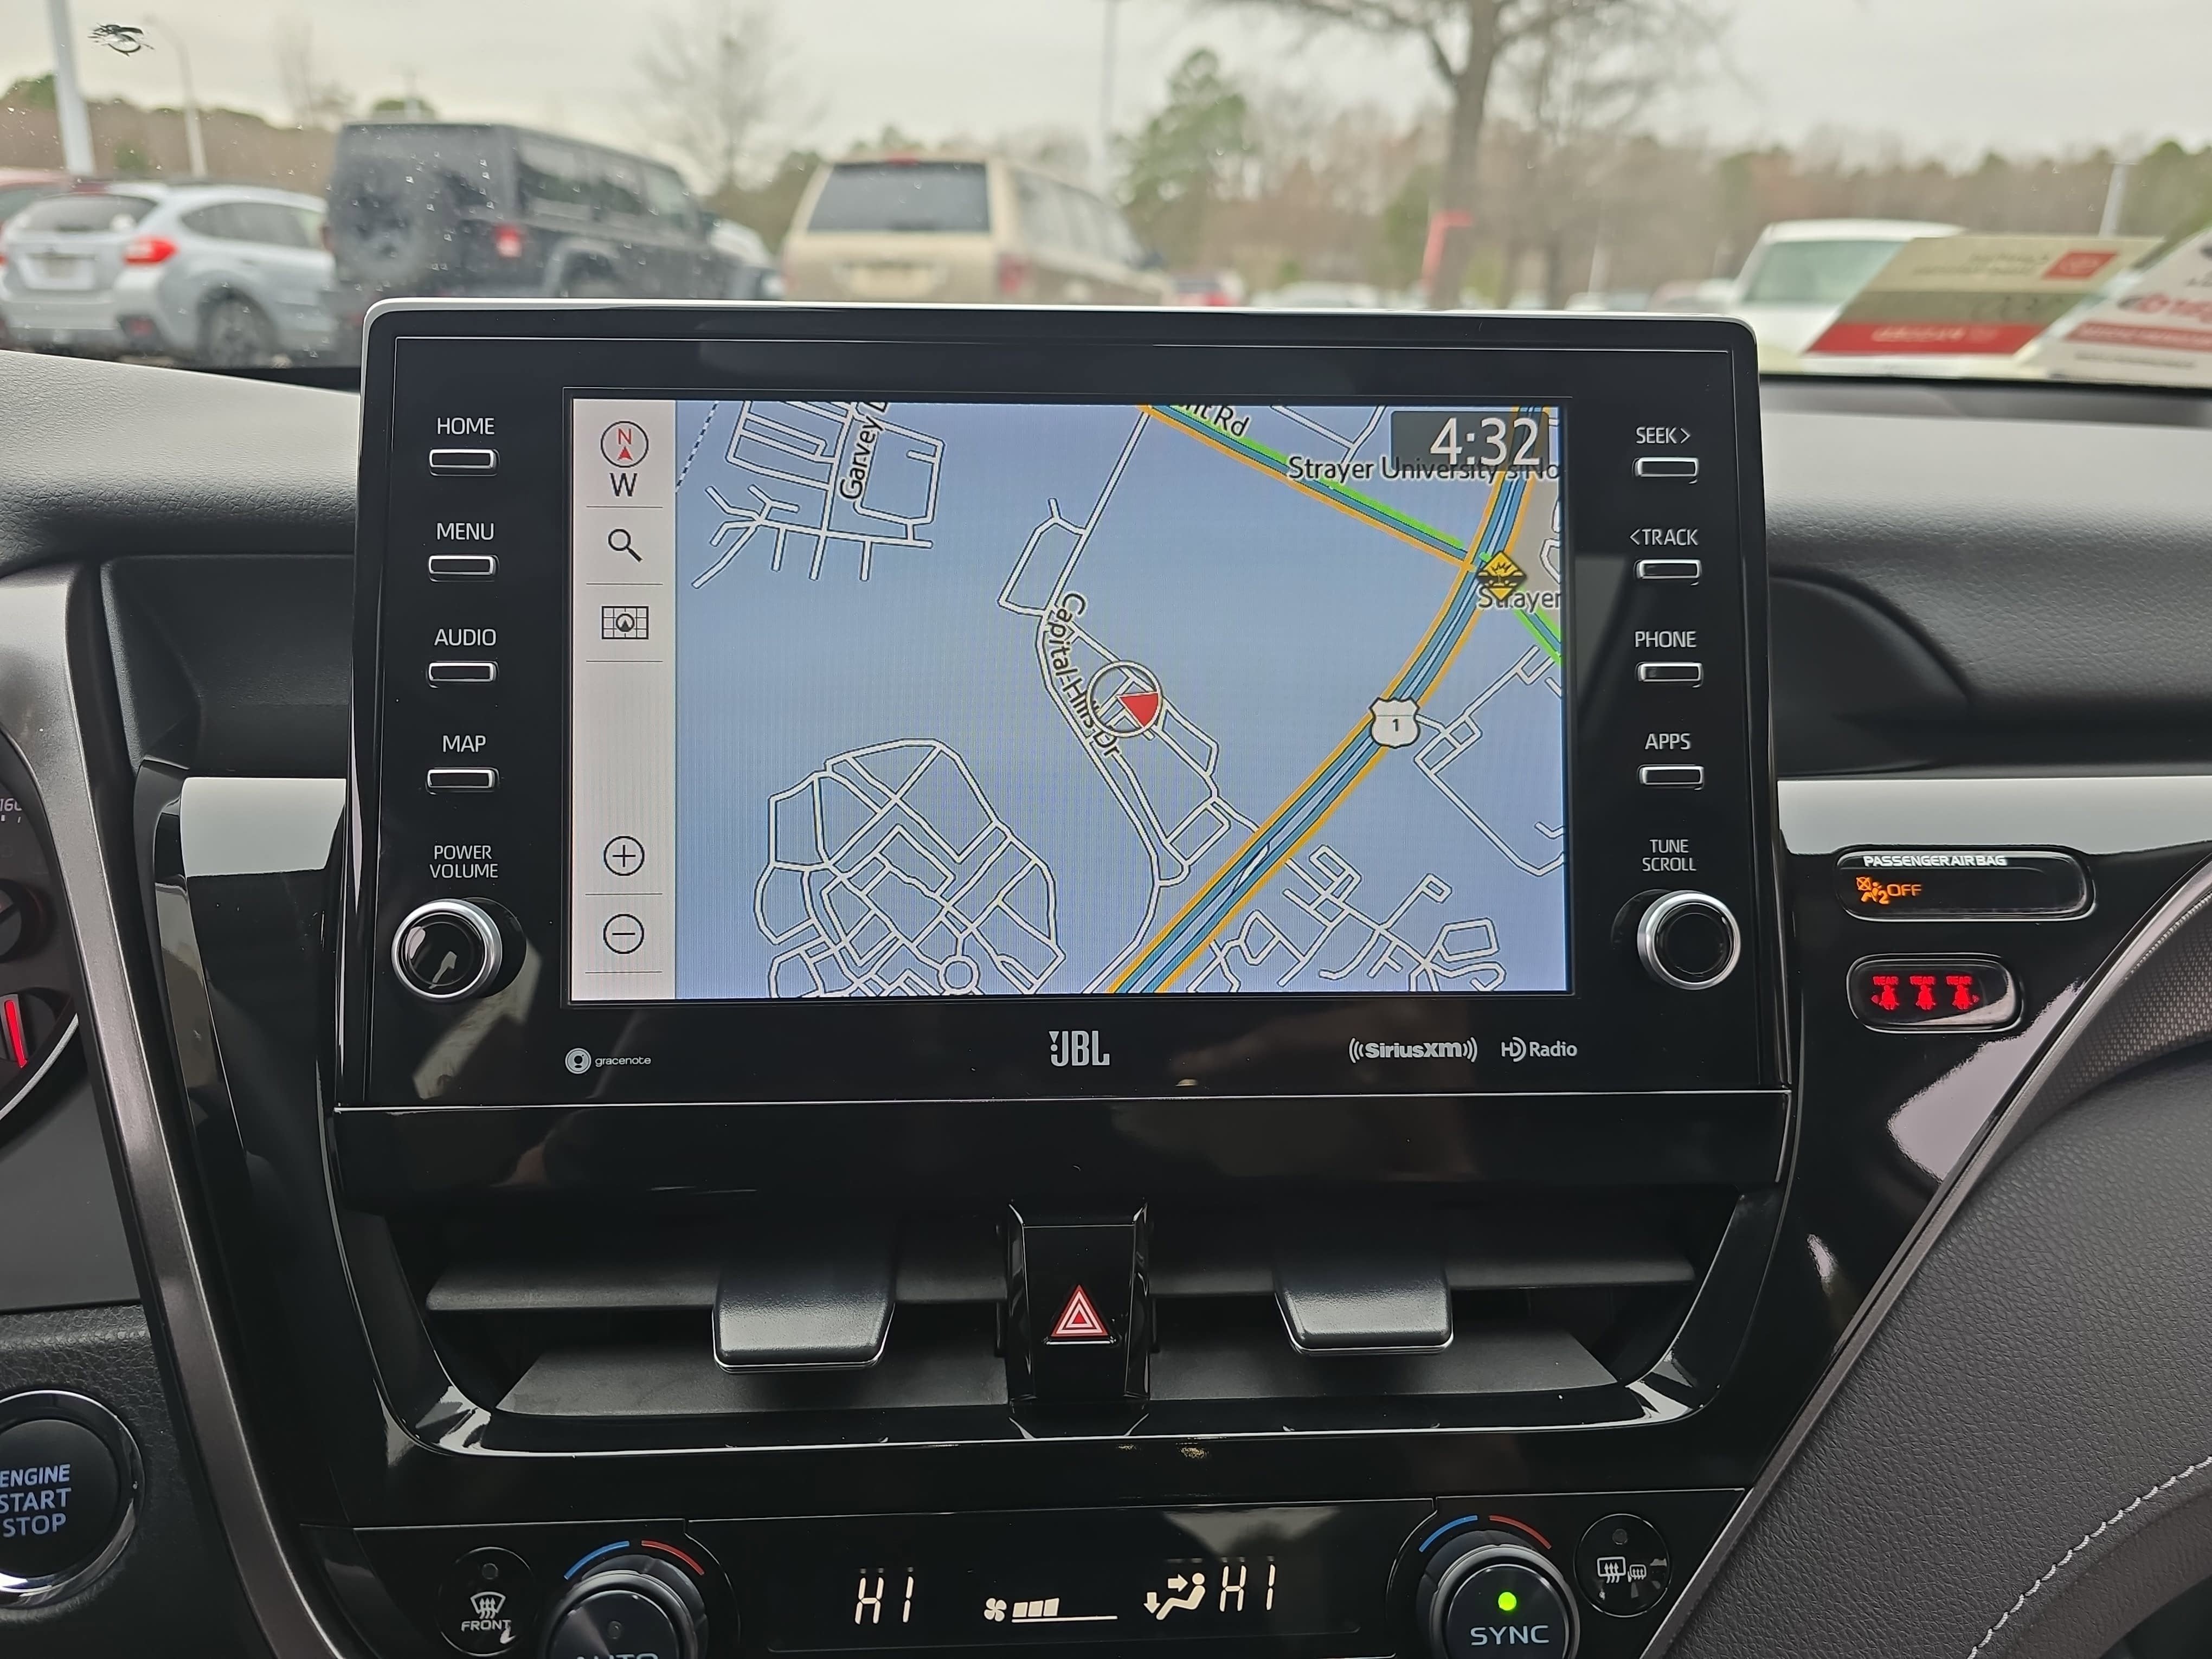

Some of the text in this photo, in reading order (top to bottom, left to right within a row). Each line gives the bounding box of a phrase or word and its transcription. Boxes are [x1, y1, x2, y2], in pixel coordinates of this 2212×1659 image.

[437, 417, 495, 435] HOME
[1213, 405, 1249, 436] Rd
[617, 428, 632, 445] N
[1430, 417, 1540, 466] 4:32
[840, 416, 884, 499] Garvey
[1289, 456, 1375, 484] Strayer
[1382, 456, 1499, 484] University
[609, 472, 638, 497] W
[436, 522, 495, 541] MENU
[434, 628, 497, 646] AUDIO
[1634, 631, 1697, 648] PHONE
[1047, 593, 1086, 676] Capital
[1092, 724, 1120, 757] Dr
[1392, 718, 1399, 732] 1
[442, 735, 486, 753] MAP
[1644, 733, 1692, 750] APPS
[434, 845, 492, 860] POWER
[1649, 839, 1689, 854] TUNE
[1642, 857, 1697, 872] SCROLL
[1863, 855, 1951, 867] PASSENGER
[429, 864, 499, 879] VOLUME
[1887, 884, 1922, 897] OFF
[1050, 1030, 1110, 1067] JBL
[1529, 1040, 1578, 1058] Radio
[595, 1056, 652, 1068] gracenote
[0, 1464, 71, 1488] ENGINE
[0, 1487, 72, 1514] START
[2, 1513, 67, 1538] STOP
[460, 1619, 512, 1633] FRONT
[1470, 1624, 1550, 1647] SYNC
